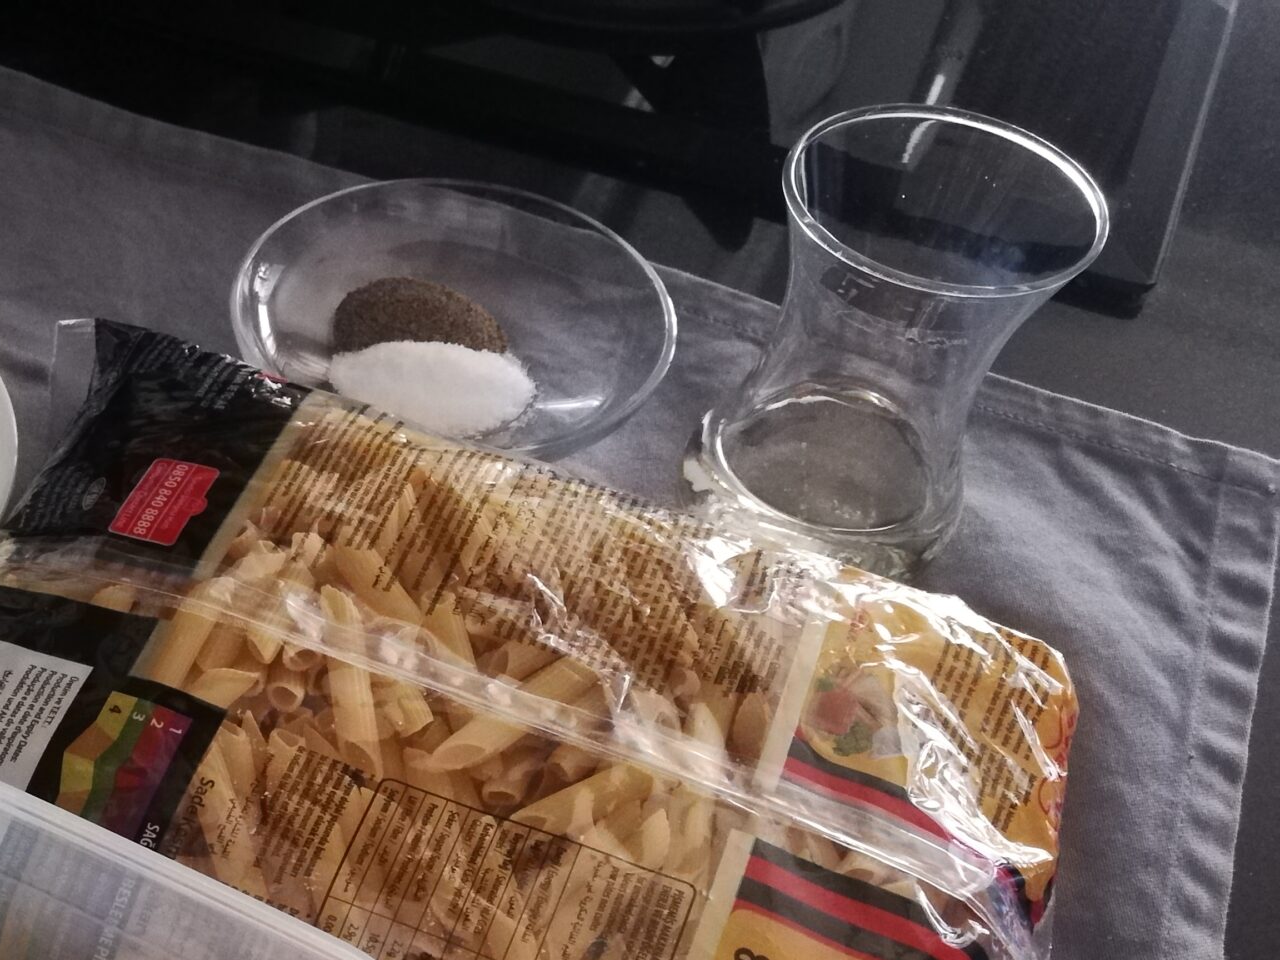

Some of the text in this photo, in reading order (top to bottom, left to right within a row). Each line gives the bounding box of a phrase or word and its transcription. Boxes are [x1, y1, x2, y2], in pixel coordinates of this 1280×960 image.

[164, 464, 188, 487] 0850
[151, 488, 171, 506] 840
[133, 508, 157, 534] 8888
[32, 669, 56, 703] Production
[42, 672, 67, 706] Production
[18, 710, 30, 724] date
[108, 705, 121, 713] 4
[132, 711, 145, 721] 3
[21, 719, 38, 739] Expiry
[150, 718, 163, 728] 2
[188, 776, 216, 815] Sade
